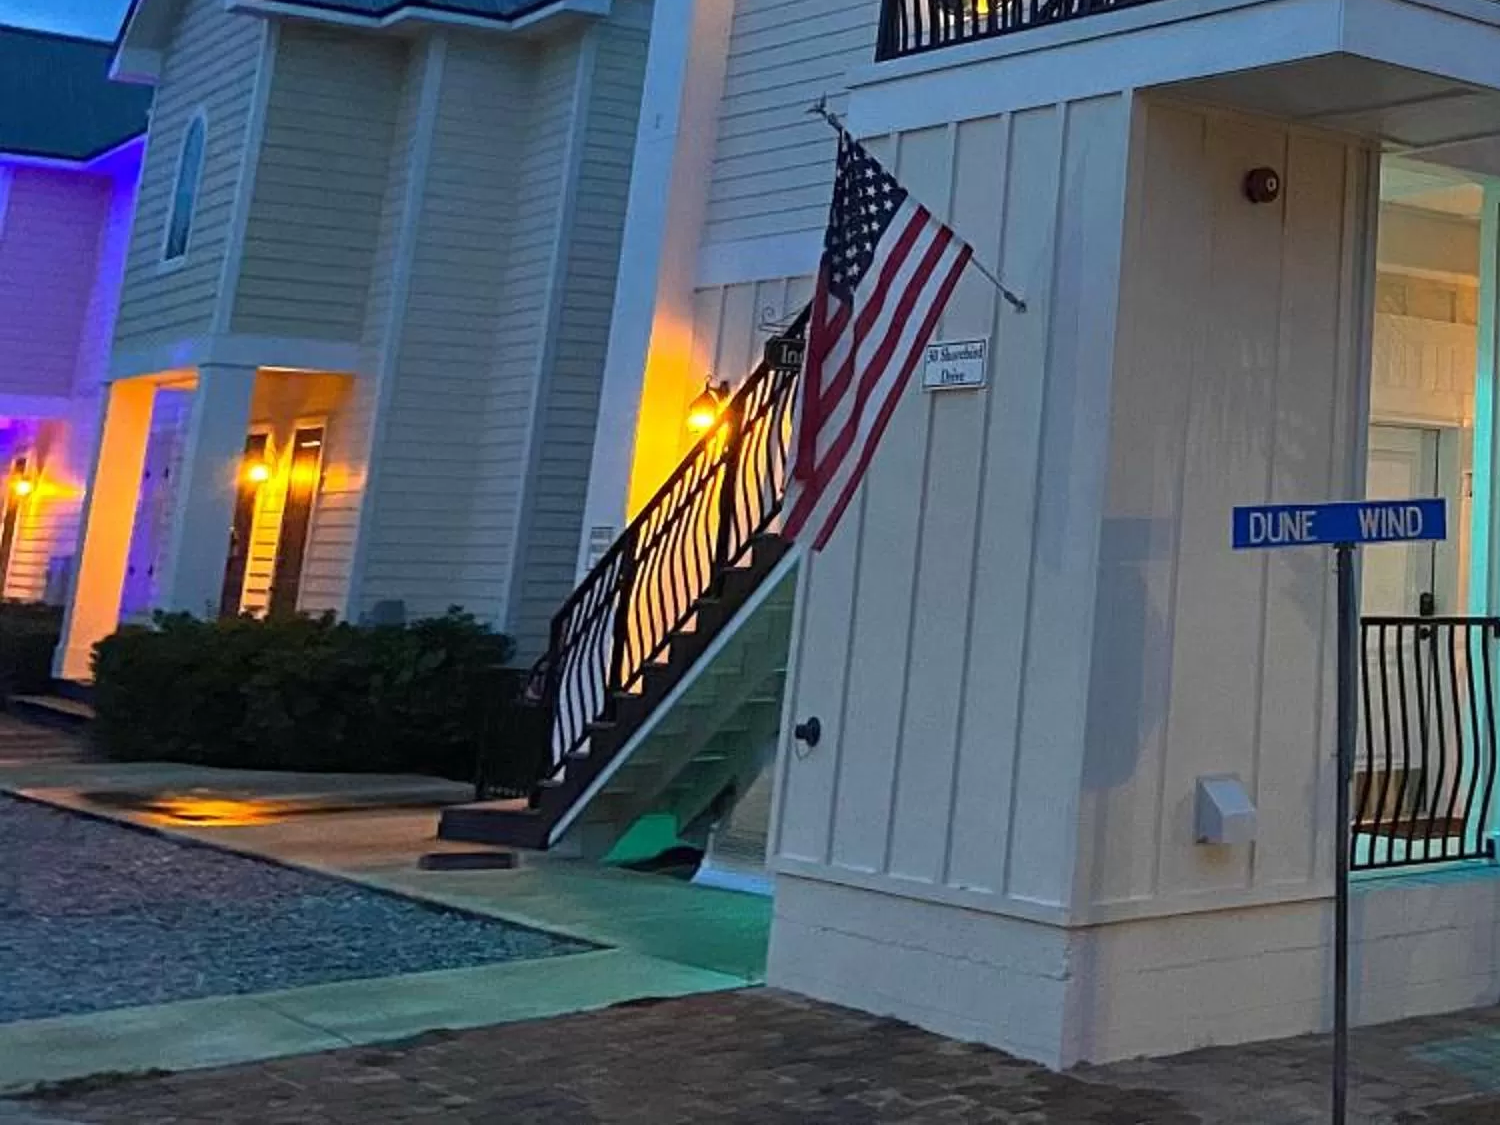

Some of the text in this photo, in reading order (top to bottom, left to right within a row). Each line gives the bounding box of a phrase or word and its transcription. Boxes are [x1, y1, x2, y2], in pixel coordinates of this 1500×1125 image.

[941, 367, 965, 383] Drive
[1249, 506, 1423, 544] DUNE WIND
